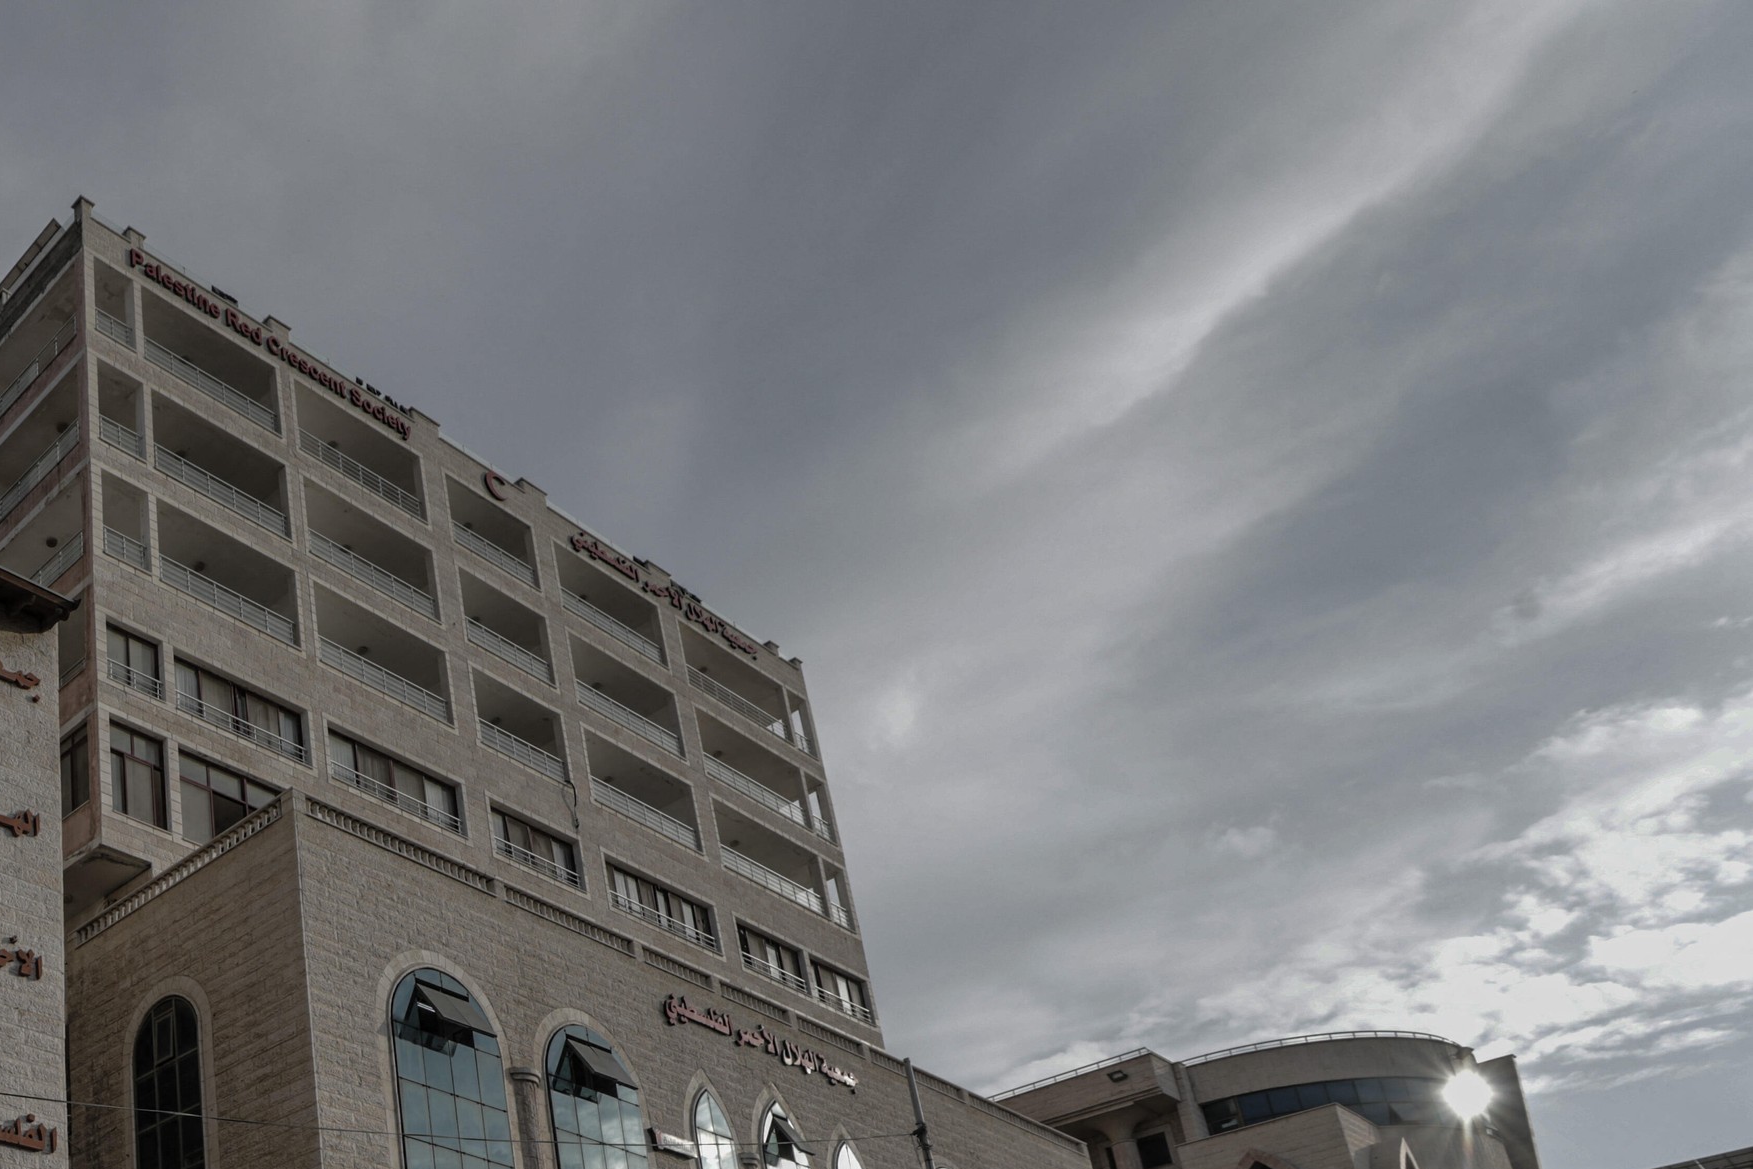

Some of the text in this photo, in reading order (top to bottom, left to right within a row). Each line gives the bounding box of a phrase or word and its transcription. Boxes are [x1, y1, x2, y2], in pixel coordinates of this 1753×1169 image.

[129, 249, 412, 440] Palestine Red Crescent Society
[664, 994, 733, 1036] الفلسطيني
[781, 1039, 819, 1074] الهلال
[817, 1053, 859, 1095] جمعية
